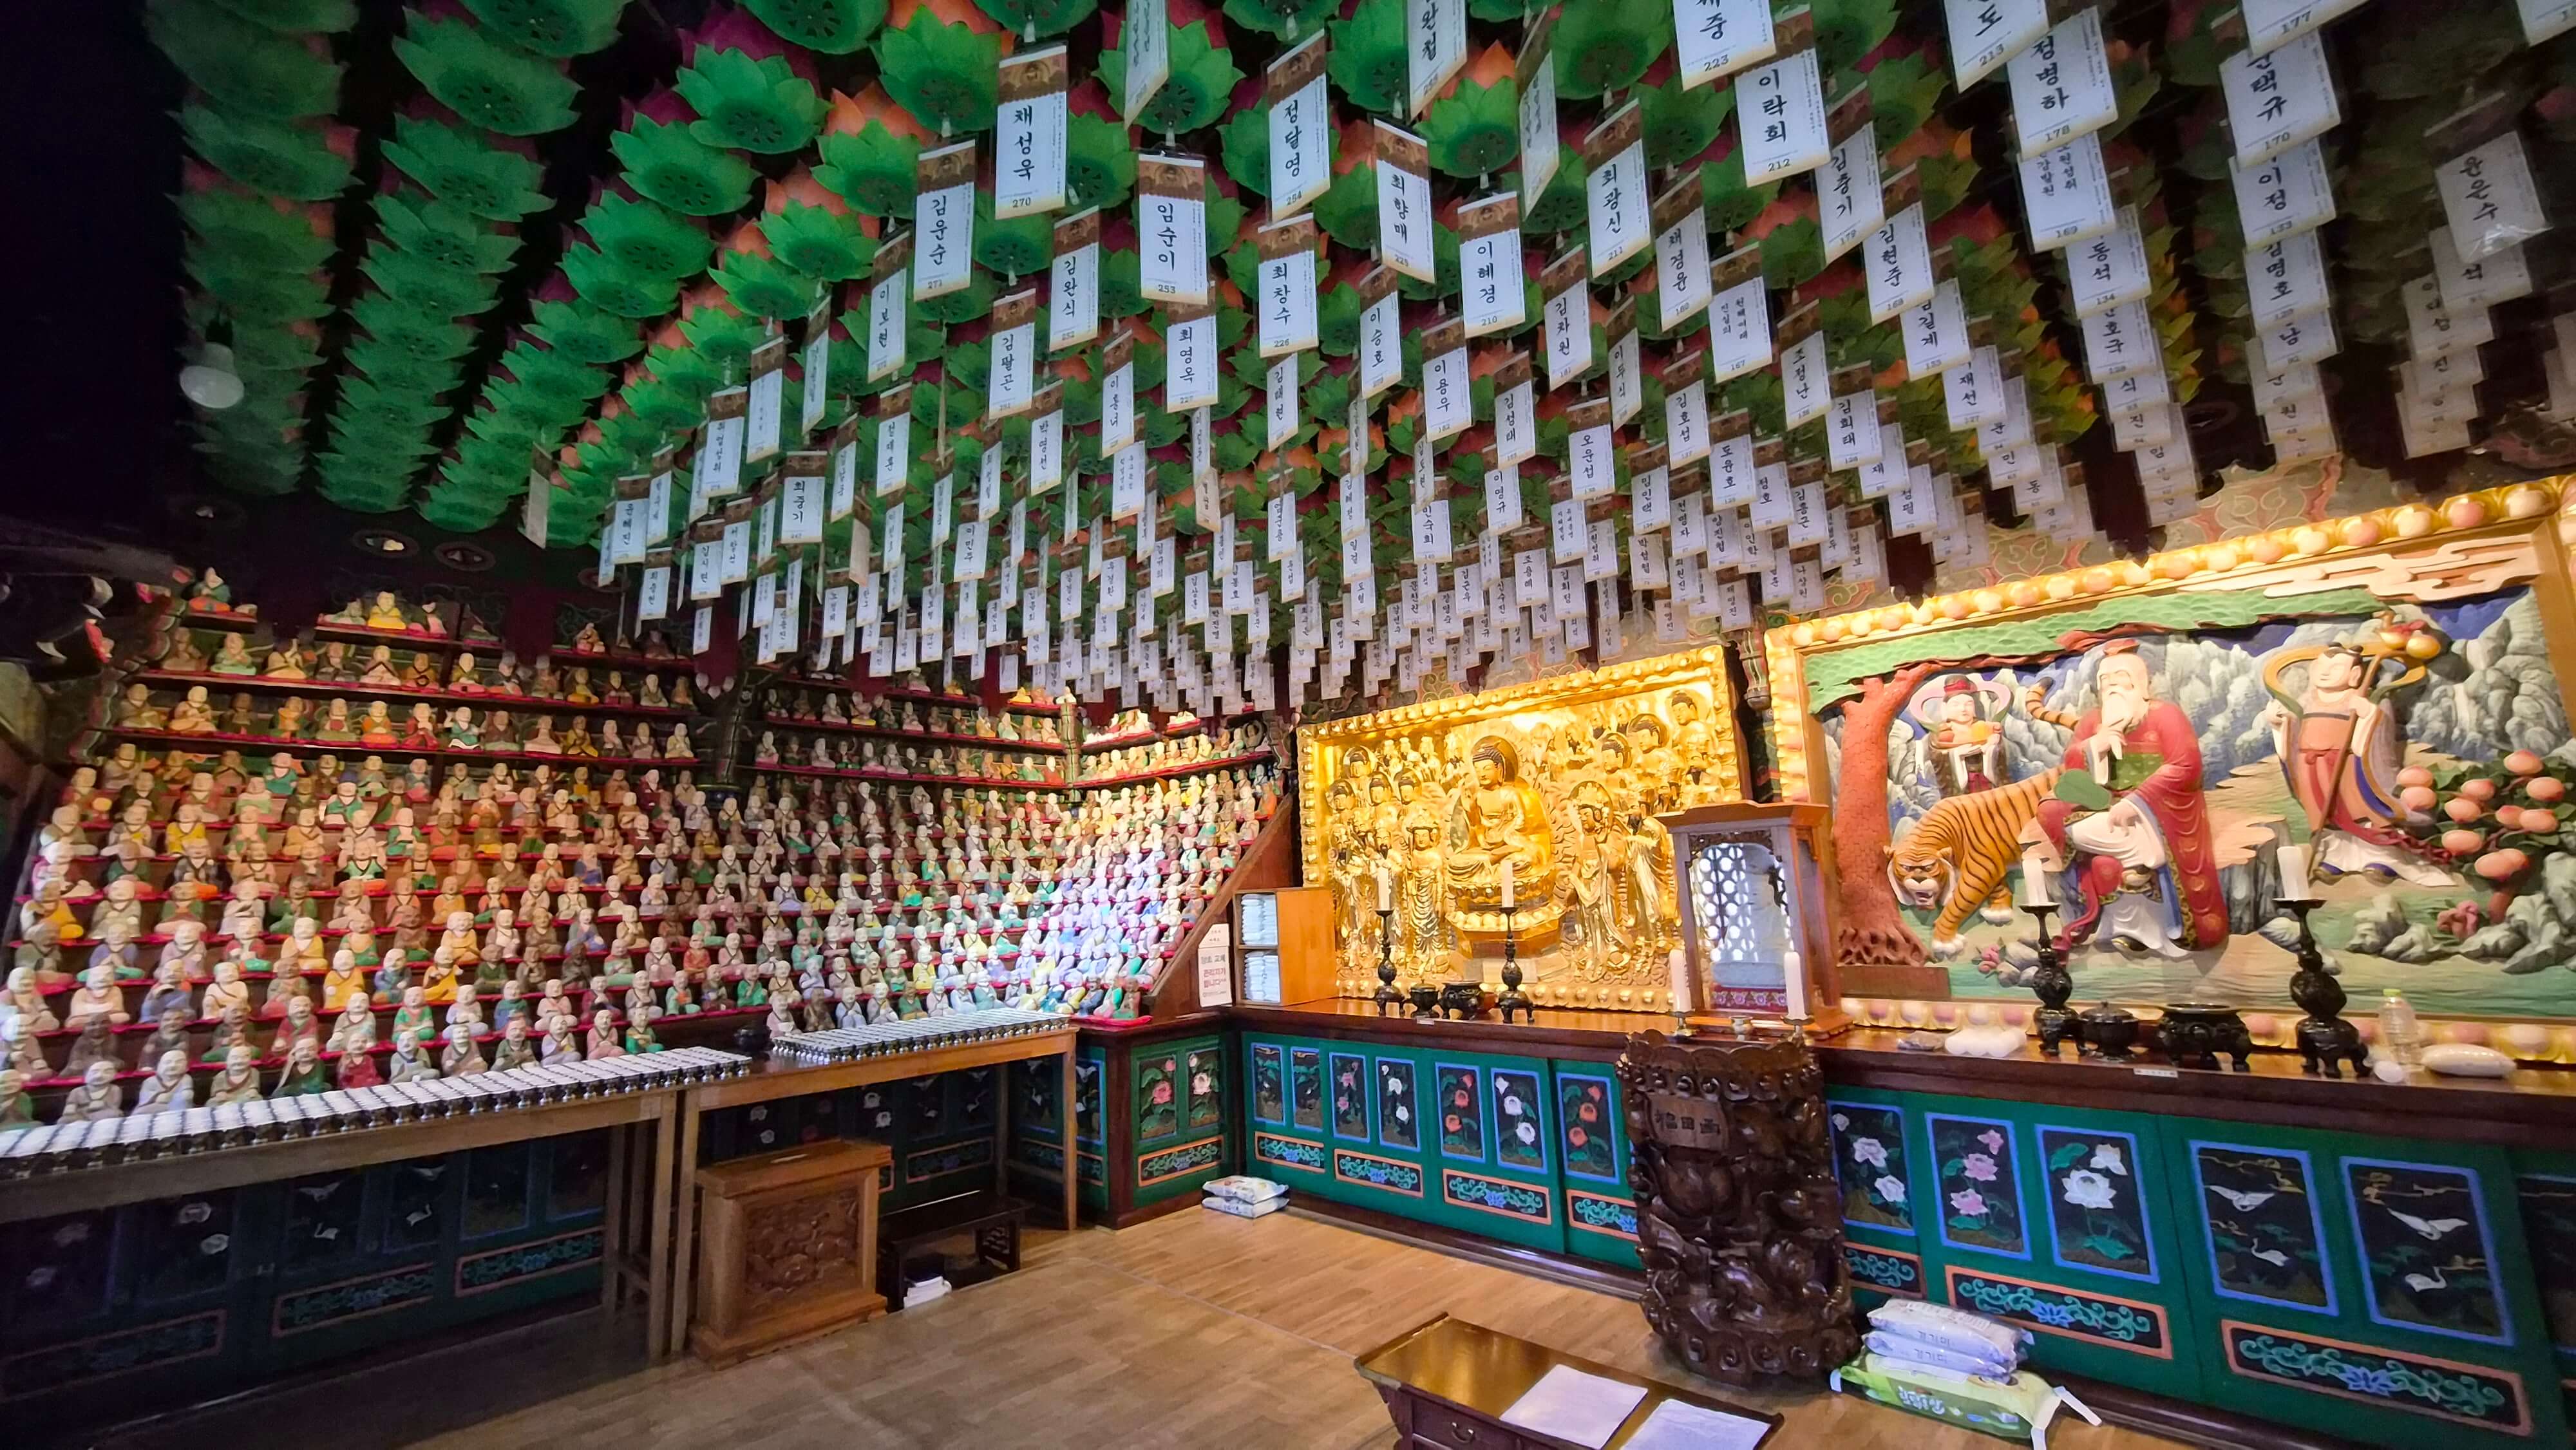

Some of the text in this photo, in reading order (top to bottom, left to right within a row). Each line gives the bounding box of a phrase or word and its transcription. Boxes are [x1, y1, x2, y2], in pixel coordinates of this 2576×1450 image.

[2281, 11, 2311, 33] 177
[1704, 54, 1729, 71] 223
[1979, 45, 2005, 65] 213
[2045, 125, 2070, 142] 178
[1013, 105, 1035, 181] 채성욱
[1768, 158, 1791, 172] 212
[1012, 197, 1032, 209] 270
[1286, 191, 1302, 205] 254
[1157, 202, 1177, 270] 임순이
[1158, 284, 1175, 294] 253
[1481, 315, 1498, 326] 210
[1274, 339, 1290, 348] 226
